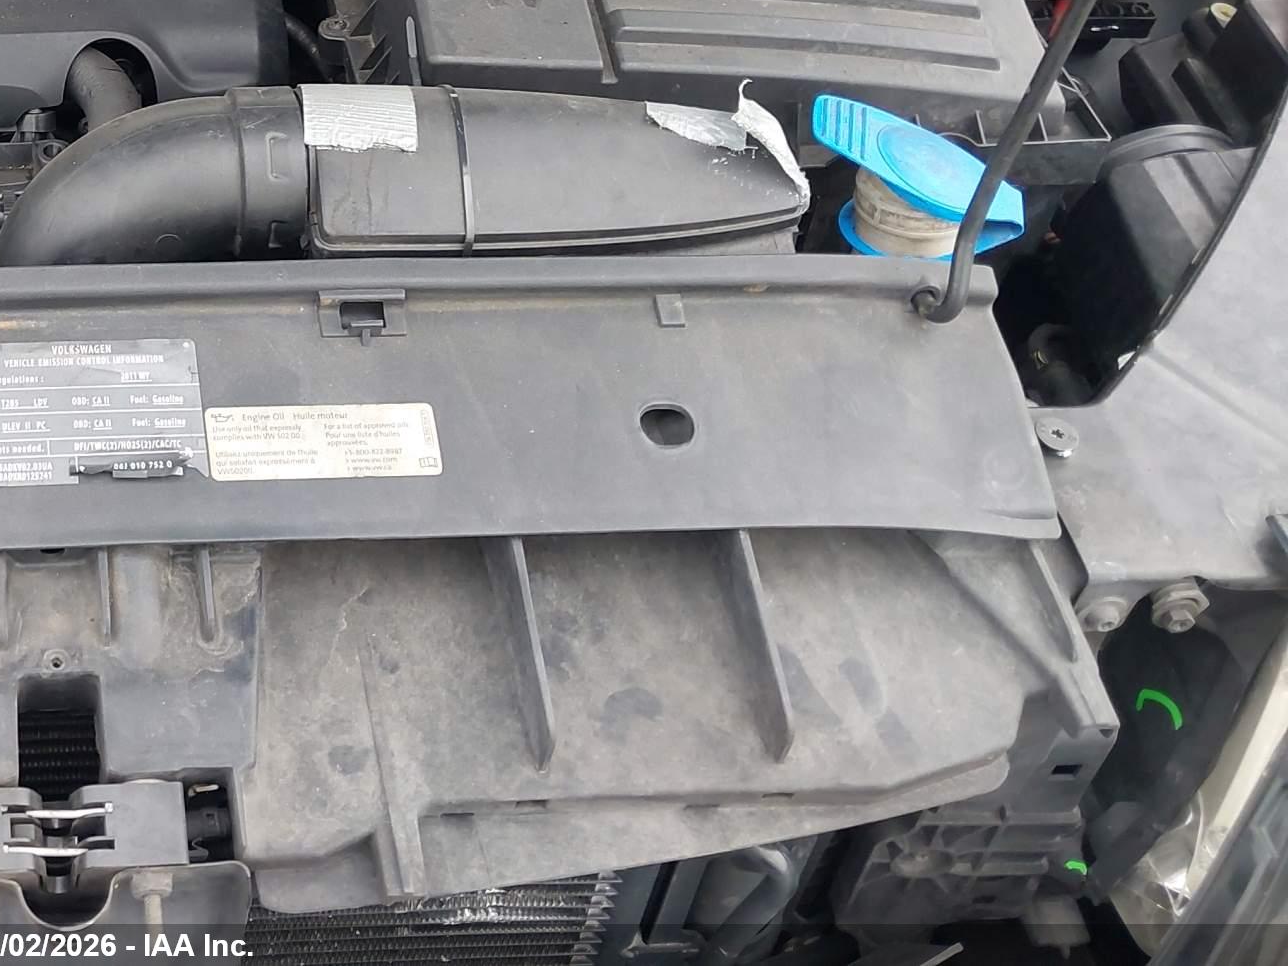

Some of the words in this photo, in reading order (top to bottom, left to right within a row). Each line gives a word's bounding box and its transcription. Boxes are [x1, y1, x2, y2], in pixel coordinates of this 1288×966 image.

[51, 344, 113, 355] VOLKSWAGEN
[3, 358, 35, 368] VEHICLE
[38, 357, 74, 367] EMISSION
[76, 355, 111, 365] CONTROL
[112, 354, 164, 364] INFORMATION
